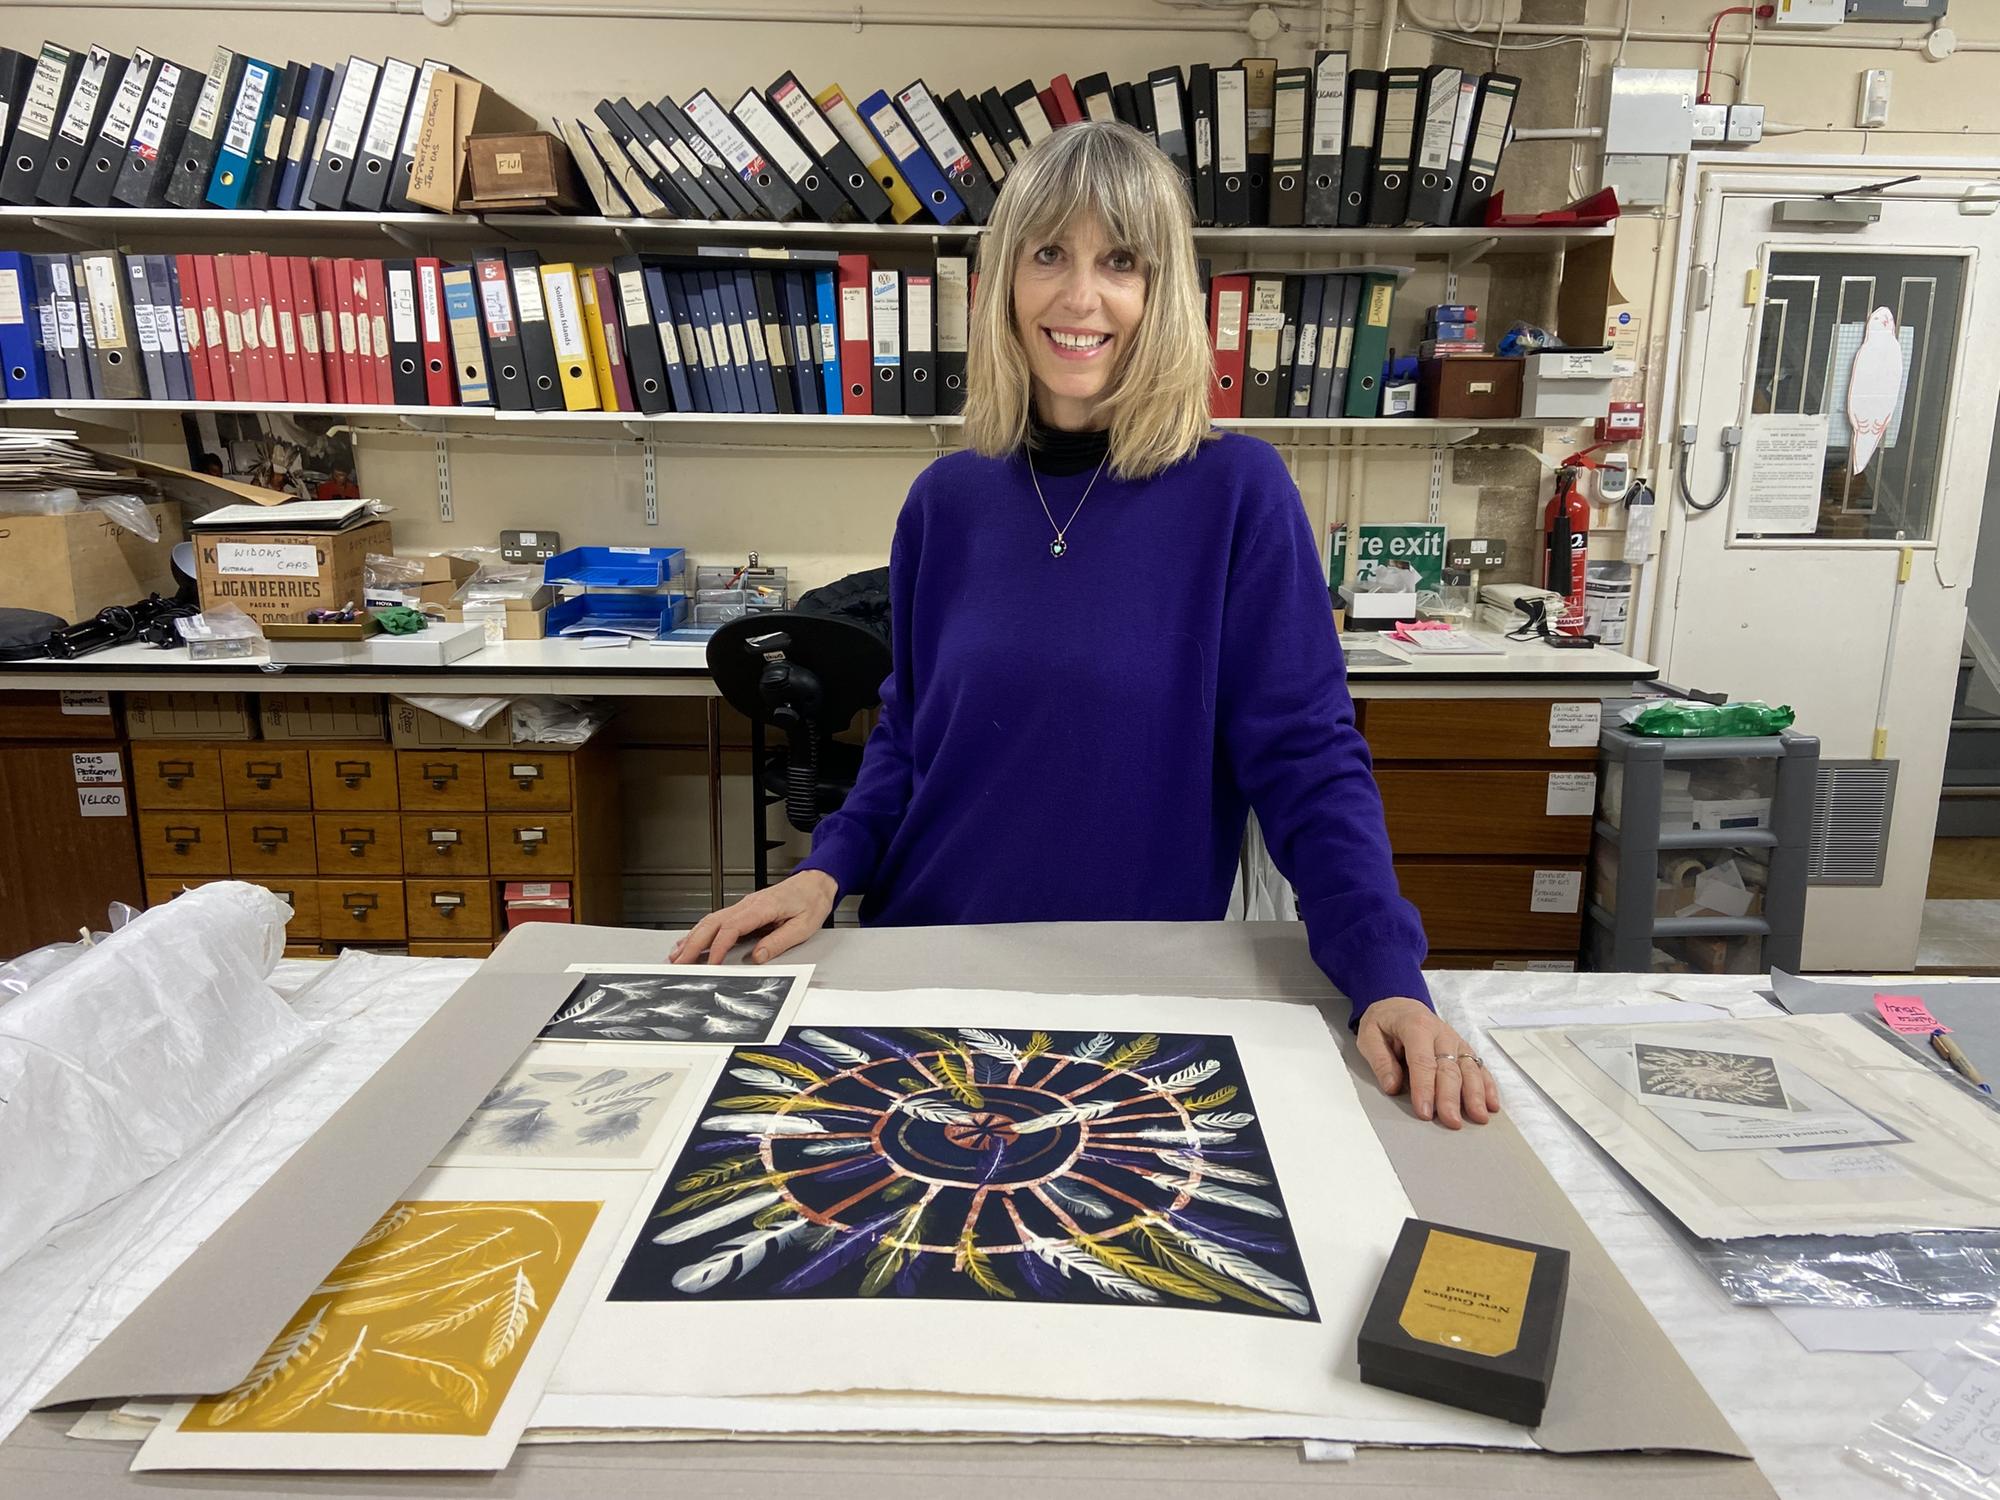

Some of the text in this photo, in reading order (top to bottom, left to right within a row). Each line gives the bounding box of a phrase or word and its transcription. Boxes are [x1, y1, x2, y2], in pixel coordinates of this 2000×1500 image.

[130, 142, 158, 159] style
[498, 159, 520, 170] FIJI
[400, 288, 411, 316] FIJI
[555, 286, 570, 346] Solomon Islands
[1334, 531, 1440, 556] Fre exit
[278, 562, 309, 570] CAPS
[214, 580, 321, 598] LOGANBERRIES
[75, 755, 103, 764] BOXES
[80, 794, 120, 805] VELCRO
[1424, 1289, 1474, 1307] Guinea
[1446, 1286, 1490, 1300] Island
[1479, 1302, 1510, 1314] New
